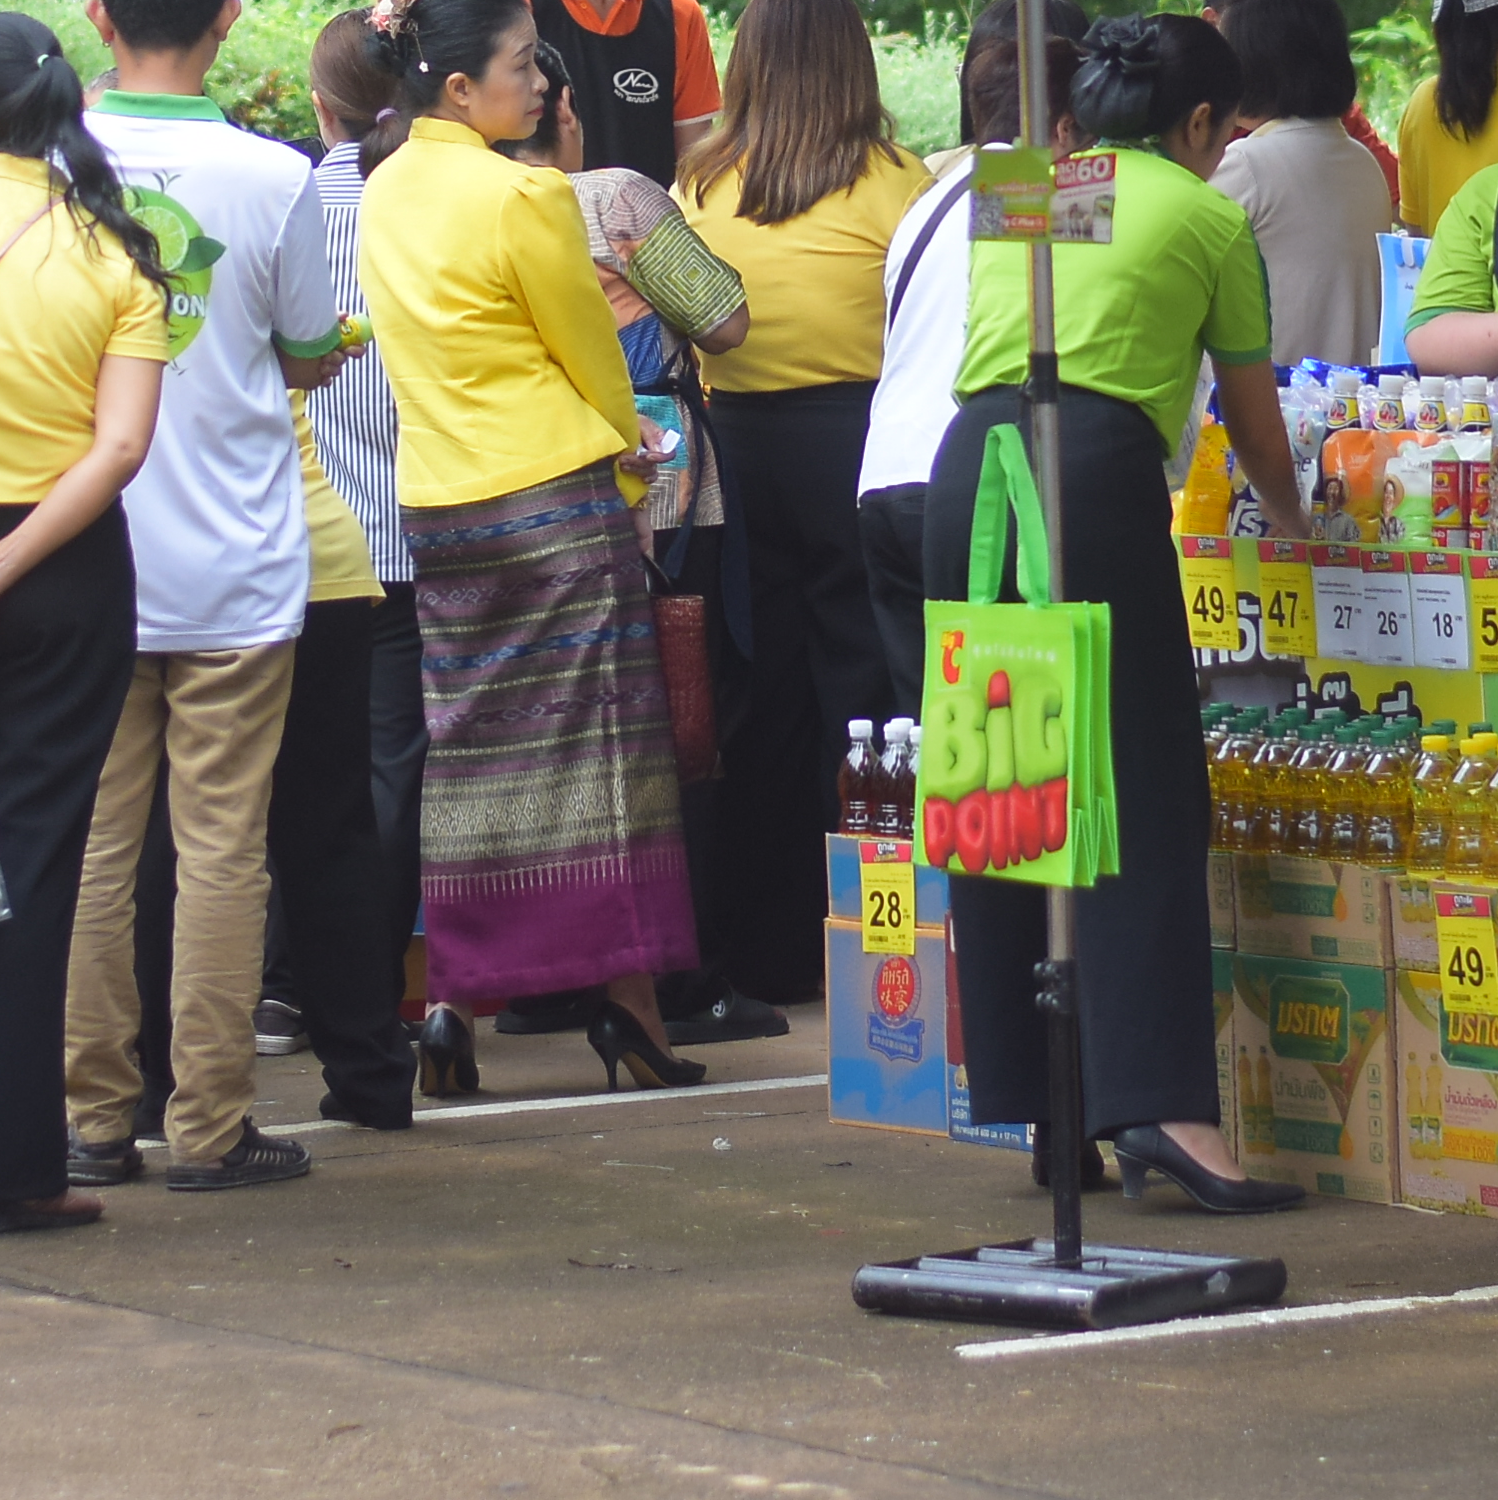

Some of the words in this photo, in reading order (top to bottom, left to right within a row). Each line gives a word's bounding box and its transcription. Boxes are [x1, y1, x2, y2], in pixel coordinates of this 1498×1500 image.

[1077, 156, 1110, 182] 60
[1192, 585, 1225, 624] 49
[1268, 590, 1299, 629] 47
[1333, 605, 1354, 630] 27
[1377, 611, 1399, 636] 26
[1432, 613, 1455, 638] 18
[923, 778, 1068, 873] POINT
[869, 890, 903, 929] 28
[1448, 945, 1485, 988] 49
[1274, 1001, 1342, 1039] มรกต
